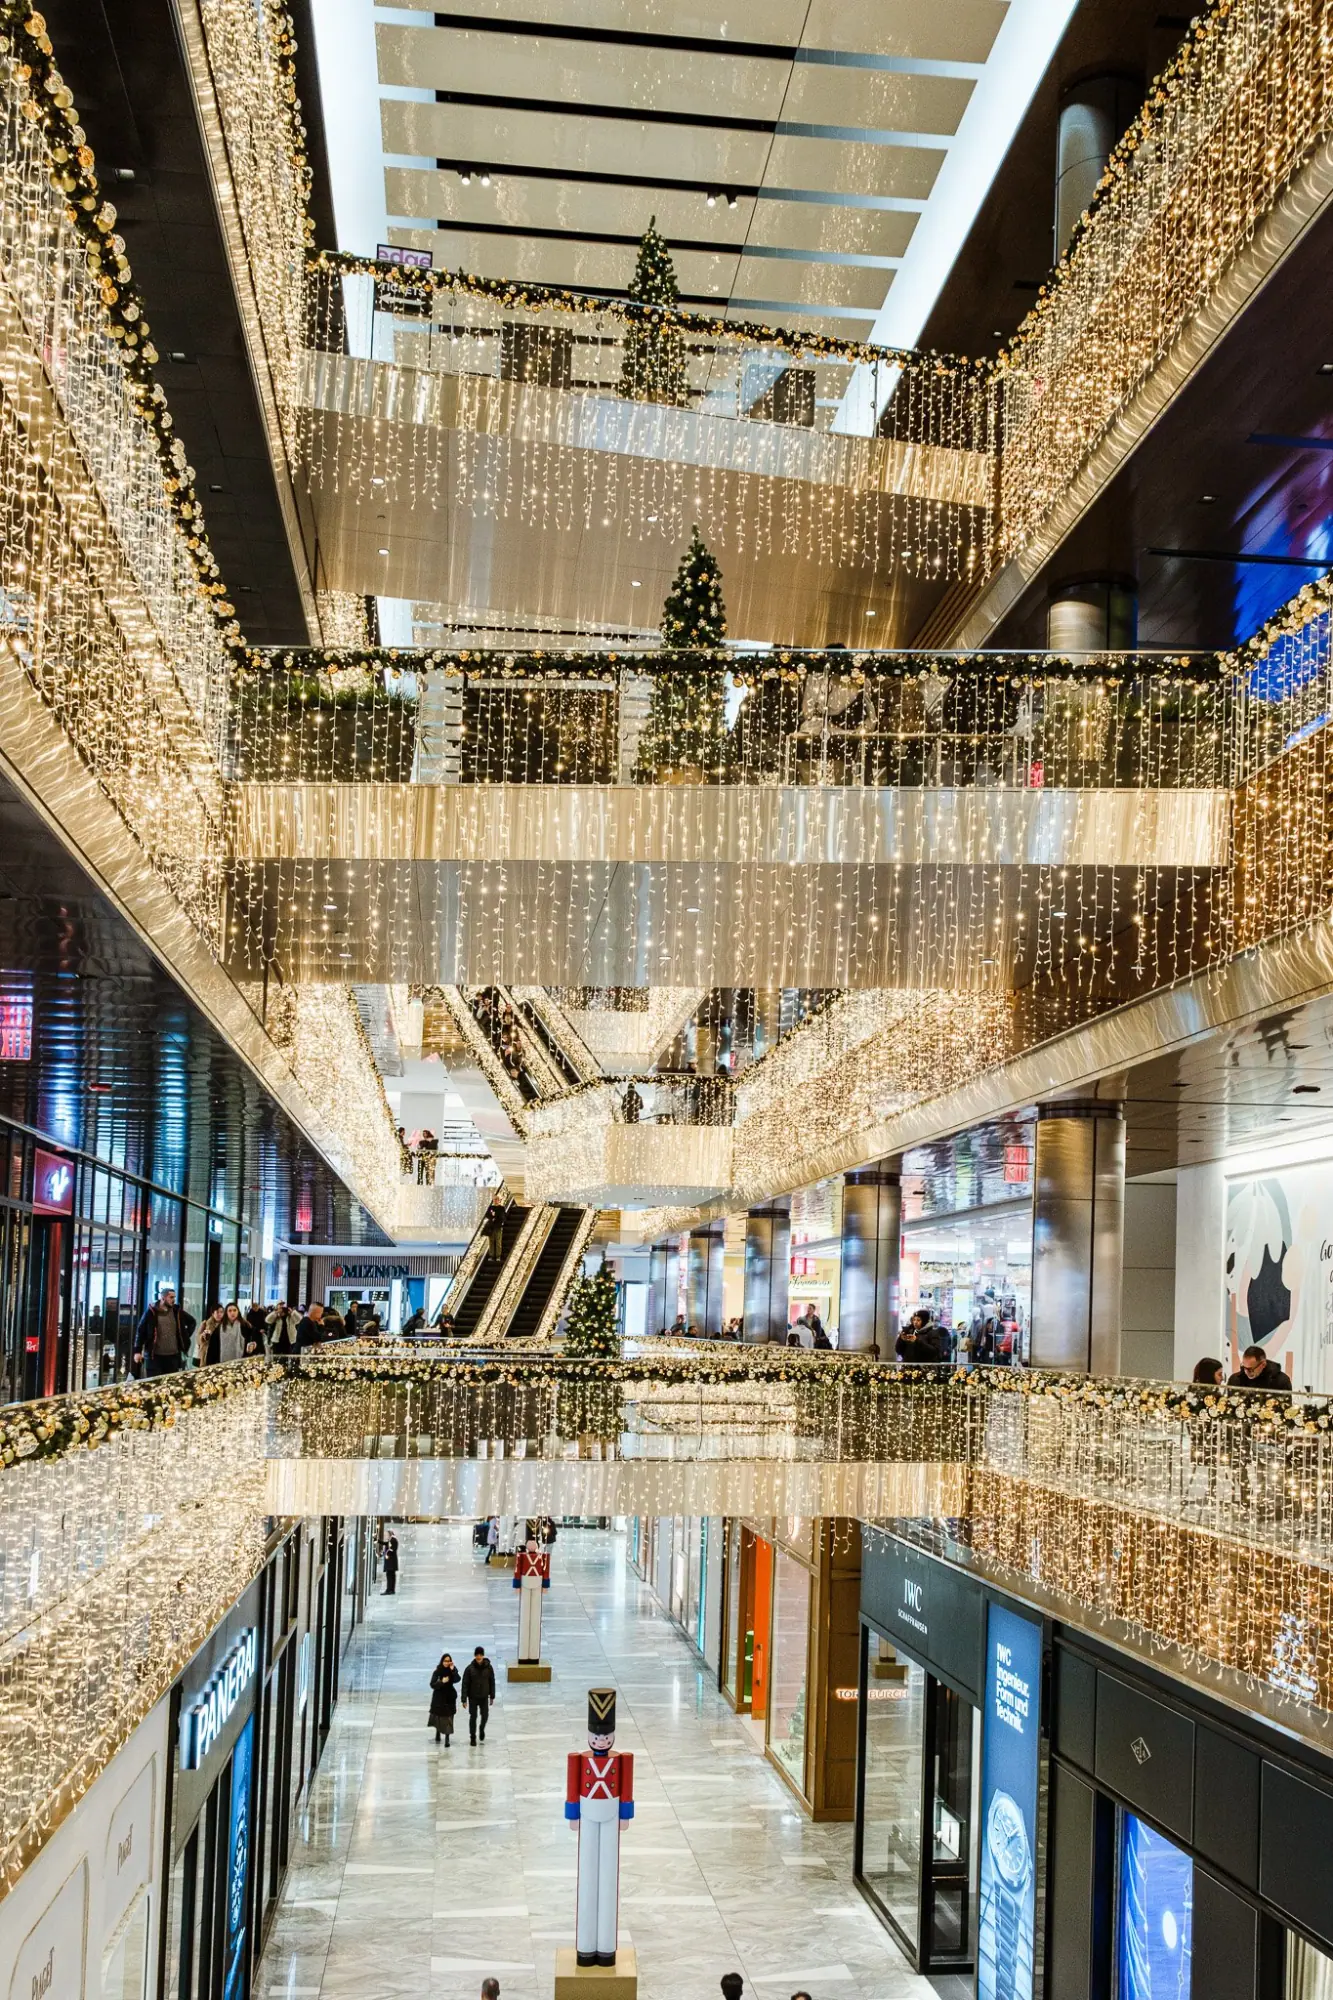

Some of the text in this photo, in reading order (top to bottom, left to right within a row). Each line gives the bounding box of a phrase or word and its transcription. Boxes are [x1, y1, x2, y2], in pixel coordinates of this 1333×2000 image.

[379, 248, 431, 267] edge
[379, 281, 427, 297] TICETS
[342, 1265, 409, 1279] MIZNON
[904, 1578, 923, 1613] IWC
[897, 1608, 928, 1635] SCHAFFHAUSEN
[996, 1642, 1012, 1667] IWC
[996, 1661, 1030, 1699] Ingenieur.
[193, 1626, 258, 1771] PANERAI
[869, 1689, 908, 1699] BURCH
[996, 1680, 1028, 1718] Form und
[995, 1698, 1025, 1735] Technik.
